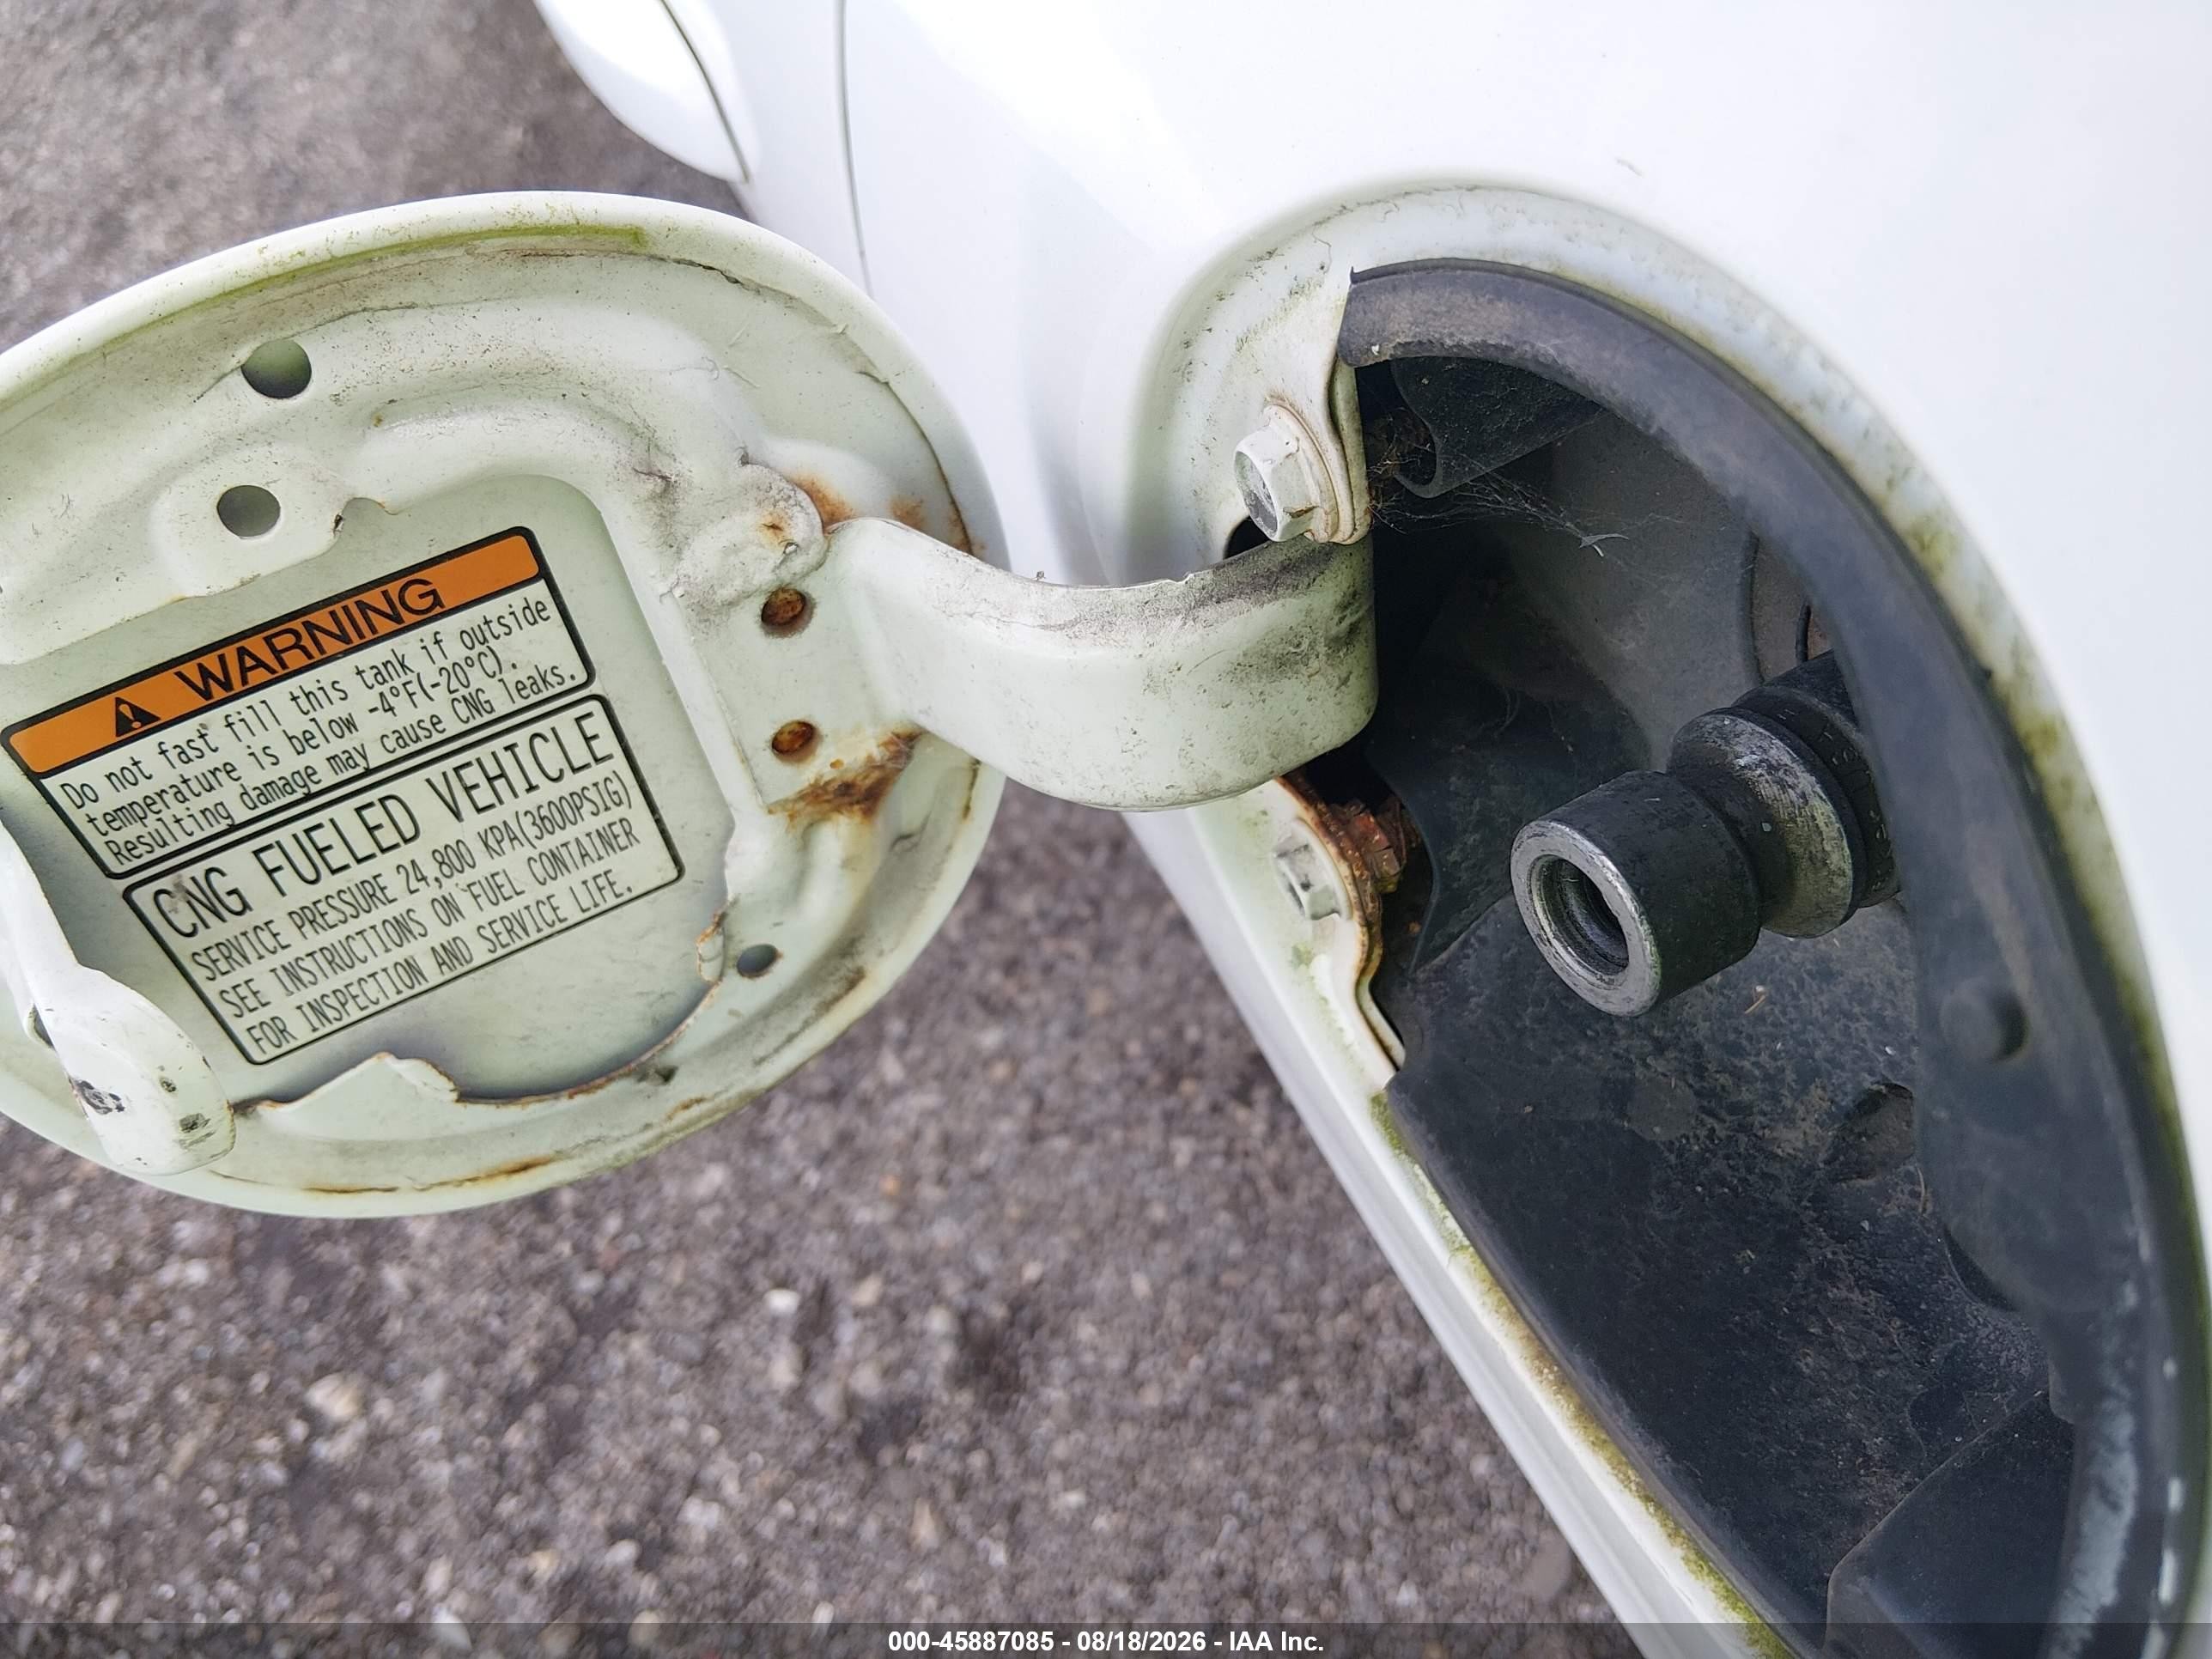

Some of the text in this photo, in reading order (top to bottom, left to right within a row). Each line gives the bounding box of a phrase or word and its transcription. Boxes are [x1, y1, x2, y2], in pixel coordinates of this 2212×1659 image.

[61, 598, 551, 810] Do not fast fill this tank if outside
[175, 579, 445, 701] WARNING
[85, 762, 243, 836] temperature
[246, 745, 280, 770] is
[284, 712, 359, 756] below
[106, 665, 576, 866] Resulting damage may cause CNG leaks.
[152, 711, 614, 939] CNG FUELED VEHICLE
[191, 770, 632, 981] SERVICE PRESSURE 24,800 KPA(3600PSIG)
[218, 817, 640, 1018] SEE INSTRUCTIONS ON FUEL CONTAINER
[246, 869, 632, 1054] FOR INSPECTION AND SERVICE LIFE.
